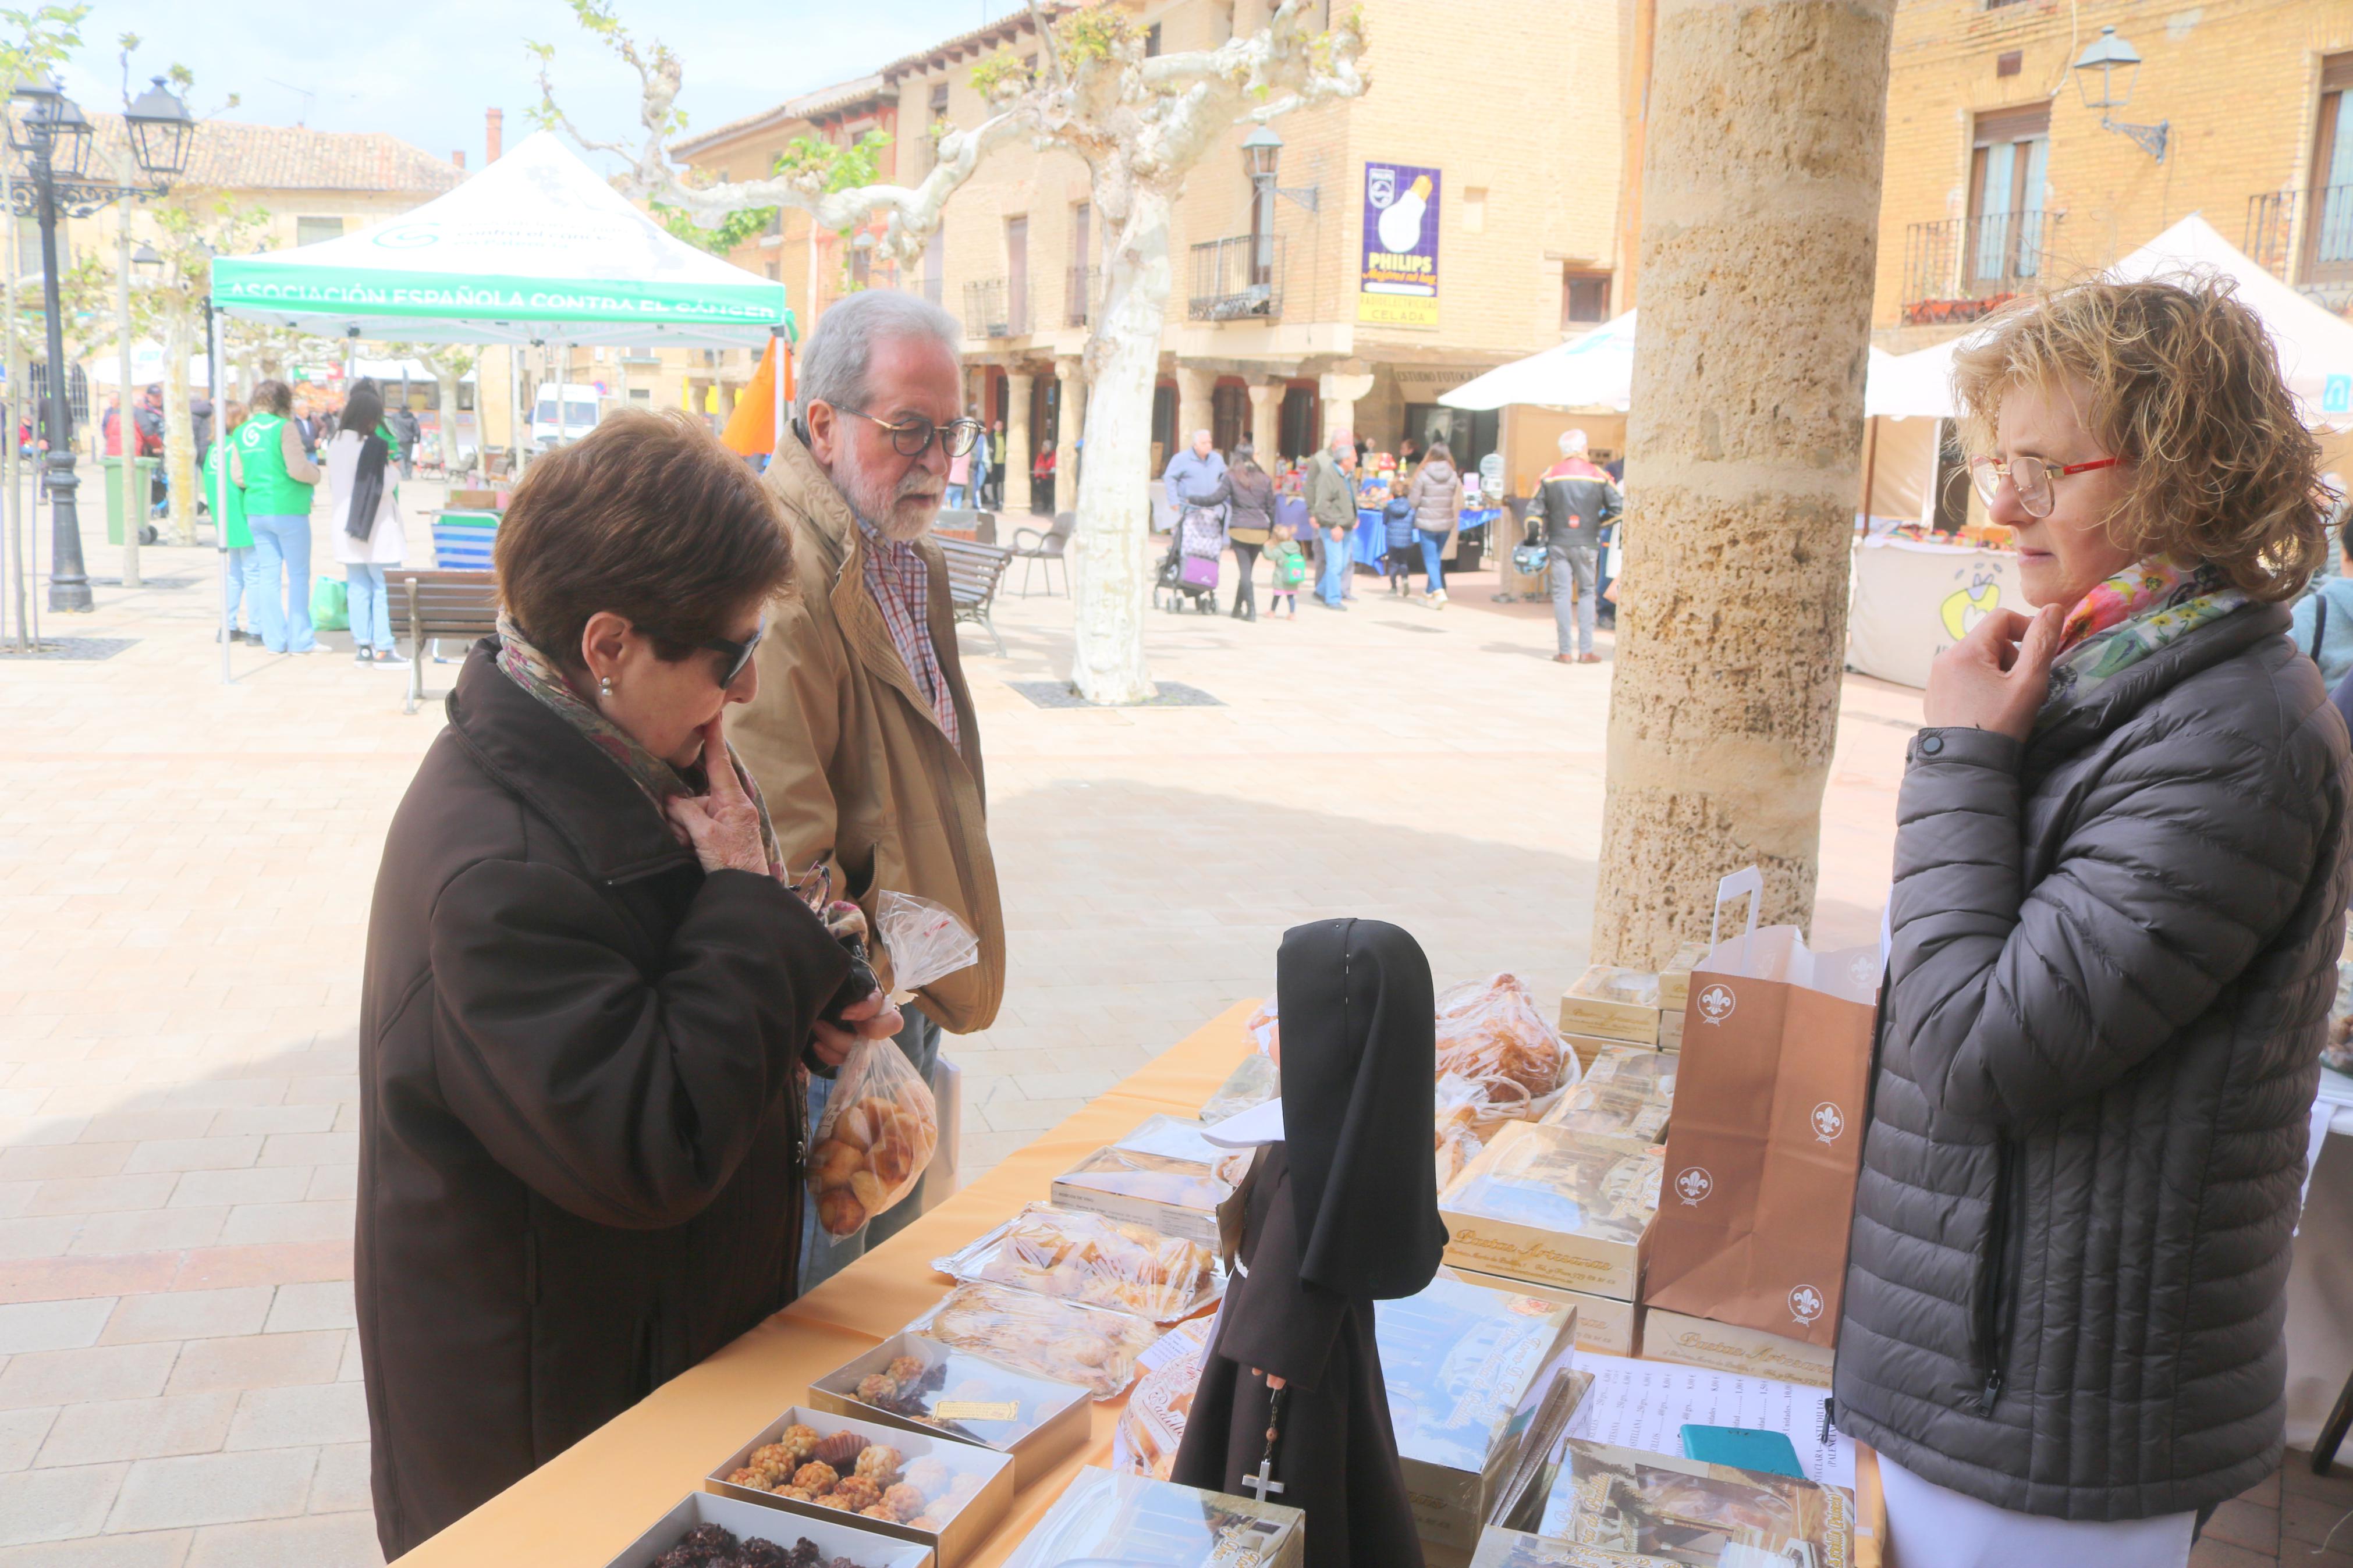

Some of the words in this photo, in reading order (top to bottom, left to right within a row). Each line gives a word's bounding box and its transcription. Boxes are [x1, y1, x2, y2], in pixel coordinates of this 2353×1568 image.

[1369, 252, 1433, 273] PHILIPS
[232, 283, 384, 303] ASOCIACIÓN
[392, 285, 524, 307] ESPAÑOLA
[530, 293, 634, 312] CONTRA
[640, 299, 669, 312] EL
[676, 299, 775, 319] CÁNCER
[1372, 308, 1425, 322] CELADA
[1396, 370, 1436, 382] ESTUDIO
[1453, 1228, 1517, 1253] Pastas
[1517, 1242, 1614, 1271] Artesanas
[1511, 1335, 1541, 1366] Horno
[1676, 1332, 1745, 1356] Pastas
[1485, 1381, 1515, 1410] Pedro
[1710, 1379, 1719, 1392] 8,00
[1735, 1382, 1744, 1395] 1,00
[1759, 1383, 1768, 1395] 1,50
[1446, 1389, 1484, 1425] Padilla
[1707, 1407, 1716, 1425] nidades
[1607, 1422, 1621, 1444] RTESANA
[1629, 1419, 1643, 1448] ASTELLANA
[1649, 1432, 1660, 1452] CILLOS
[1582, 1471, 1611, 1512] Padilla
[1579, 1513, 1600, 1528] de
